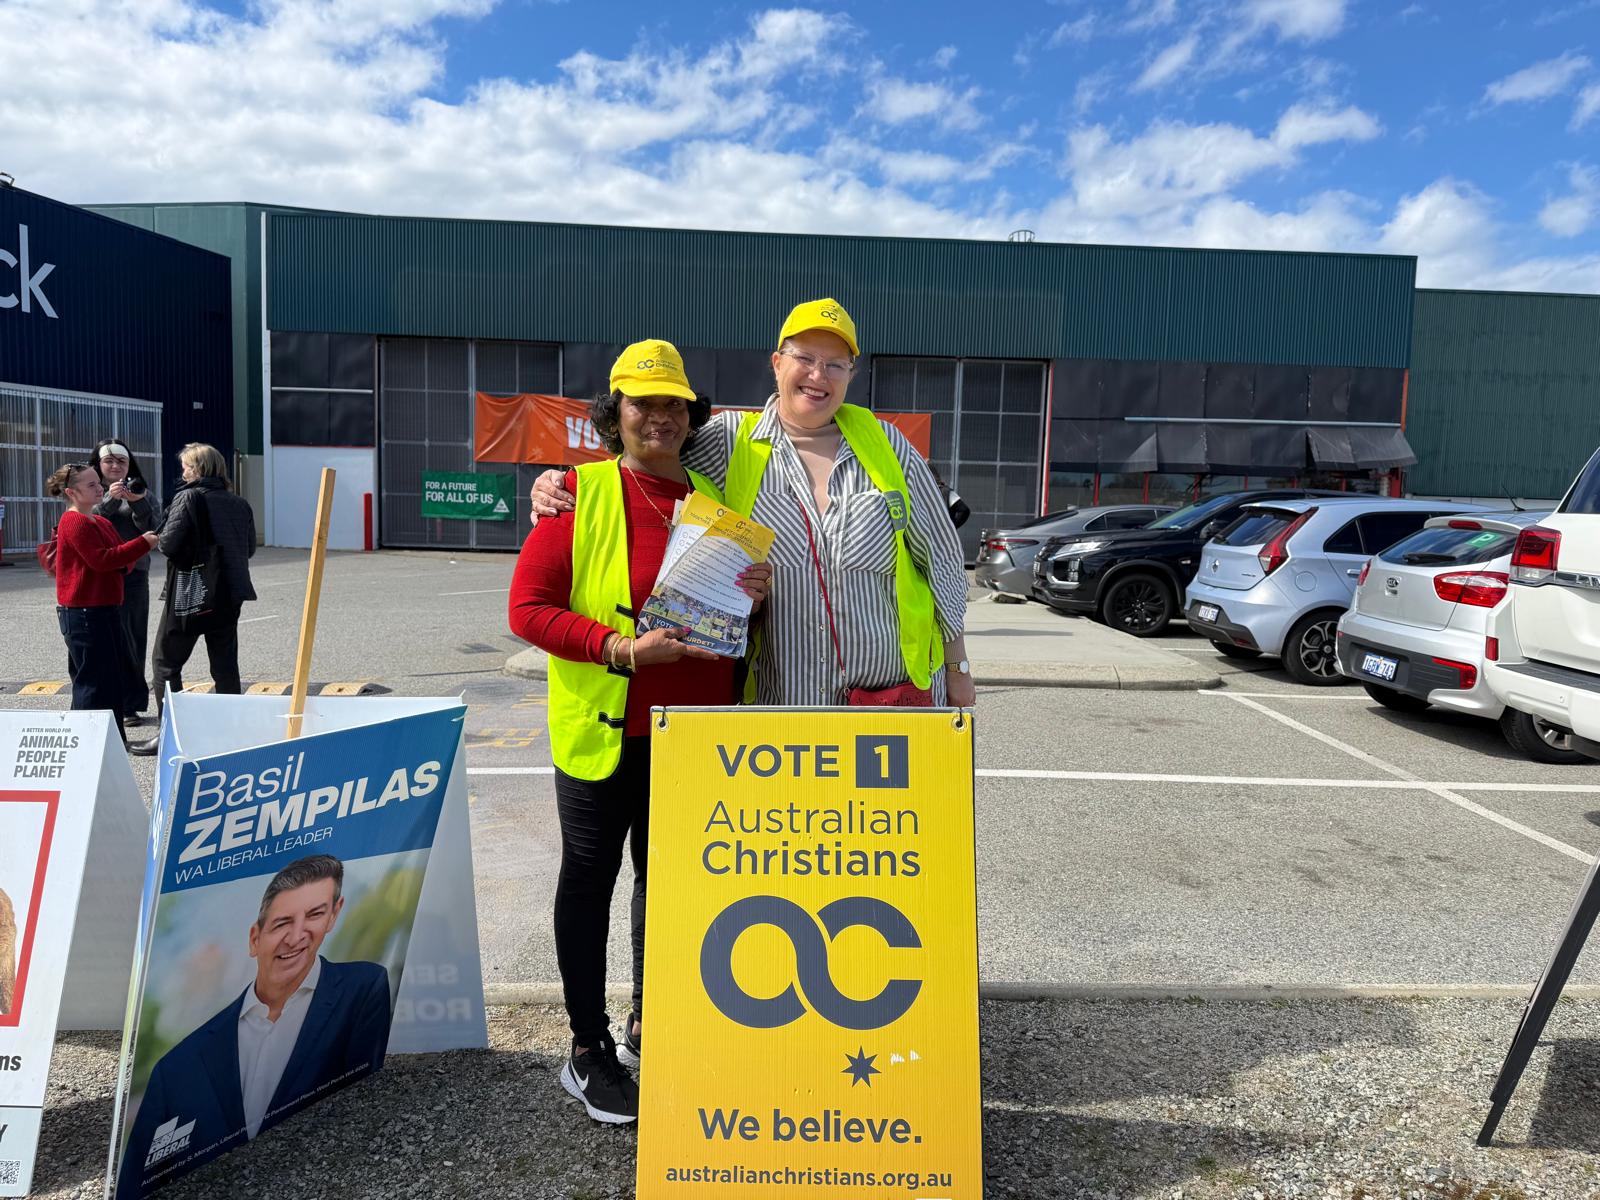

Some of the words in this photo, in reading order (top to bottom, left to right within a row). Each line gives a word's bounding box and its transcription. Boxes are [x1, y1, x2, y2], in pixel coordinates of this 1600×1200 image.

[425, 481, 440, 490] FOR
[441, 482, 448, 490] A
[448, 482, 477, 492] FUTURE
[425, 491, 445, 502] FOR
[446, 492, 465, 503] ALL
[466, 493, 479, 504] OF
[480, 494, 494, 504] US
[16, 750, 67, 763] PEOPLE
[19, 735, 80, 749] ANIMALS
[13, 765, 65, 778] PLANET
[716, 744, 840, 778] VOTE
[873, 745, 890, 779] 1
[188, 751, 305, 817] Basil
[178, 761, 441, 864] ZEMPILAS
[704, 800, 920, 836] Australian
[175, 864, 204, 885] WA
[207, 847, 271, 874] LIBERAL
[275, 826, 333, 853] LEADER
[702, 840, 921, 877] Christians
[697, 1108, 760, 1142] We
[772, 1109, 922, 1144] believe.
[144, 1135, 191, 1168] LIBERAL
[665, 1165, 953, 1190] australianchristians.org.au
